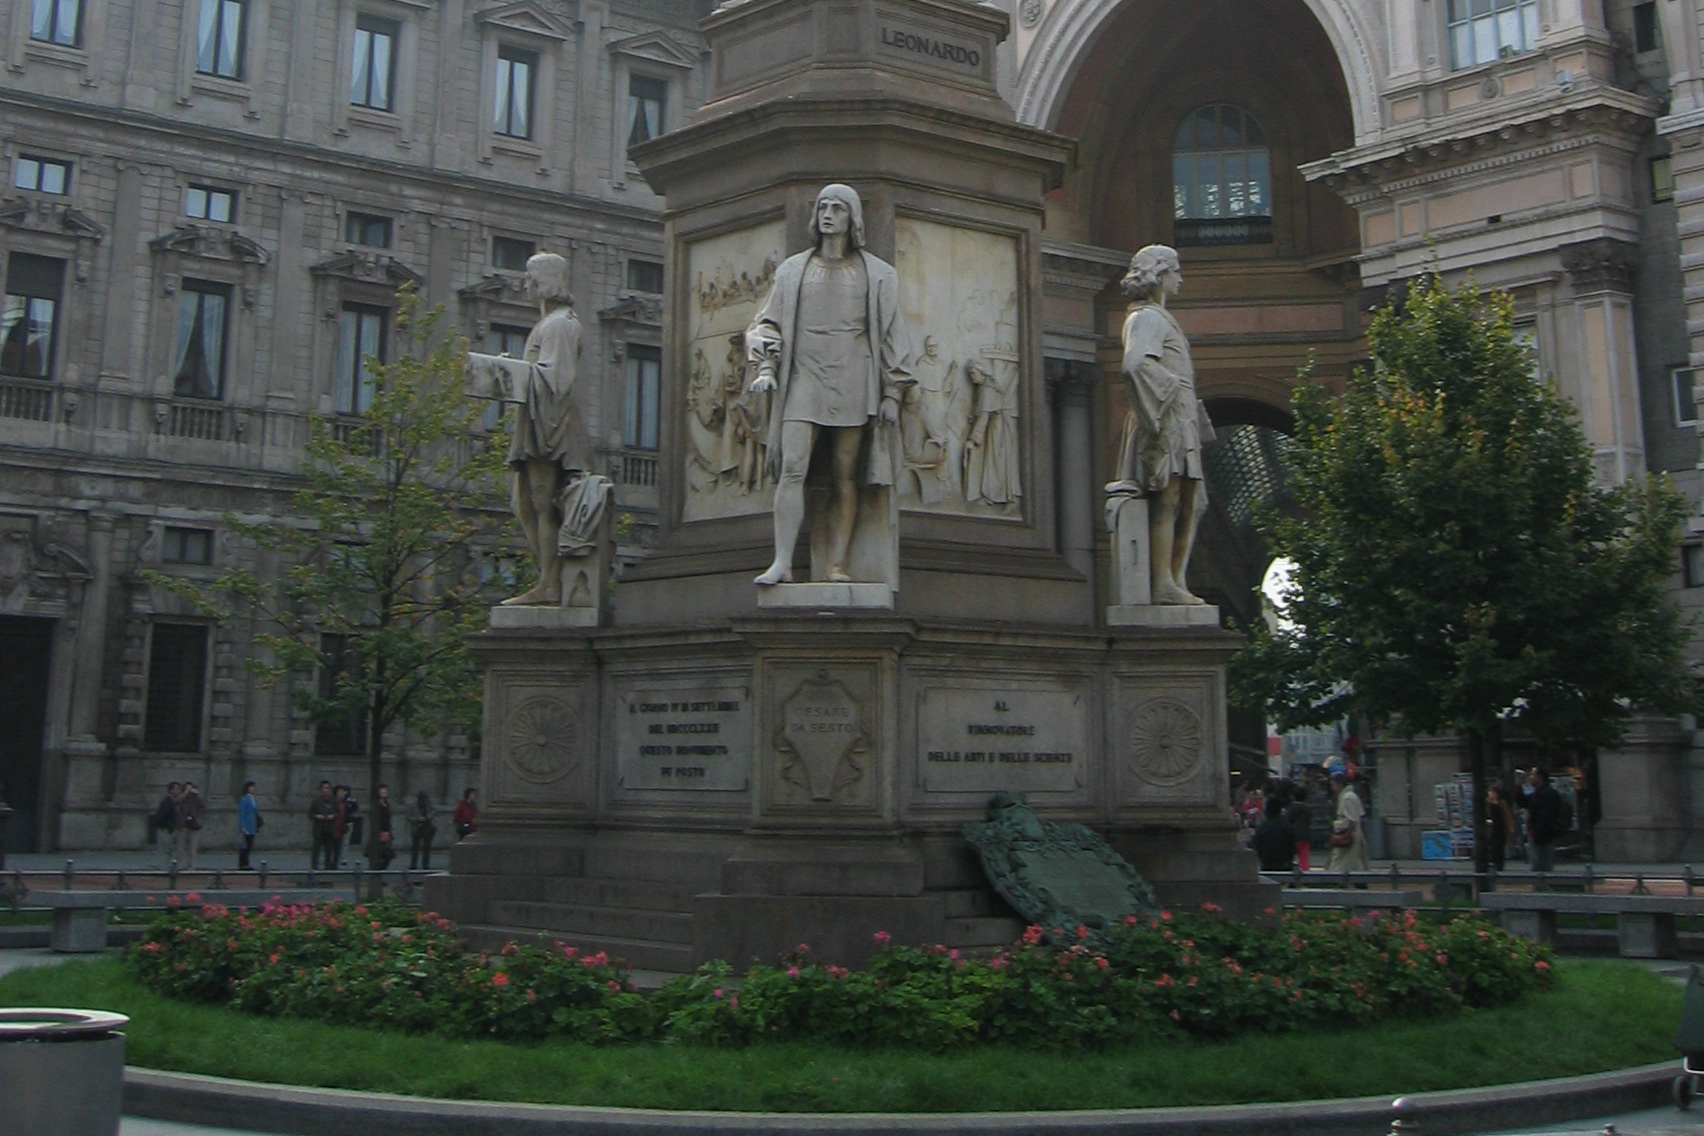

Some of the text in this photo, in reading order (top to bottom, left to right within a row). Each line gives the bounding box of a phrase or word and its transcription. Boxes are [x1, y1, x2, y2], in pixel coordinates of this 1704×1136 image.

[881, 27, 980, 67] LEONARDO
[993, 700, 1010, 712] AL
[794, 707, 849, 717] CESARE
[791, 723, 853, 733] DA SESTO
[928, 751, 1073, 763] DELLE ARTI E DELLE SCIENZE
[675, 766, 705, 777] POSTO
